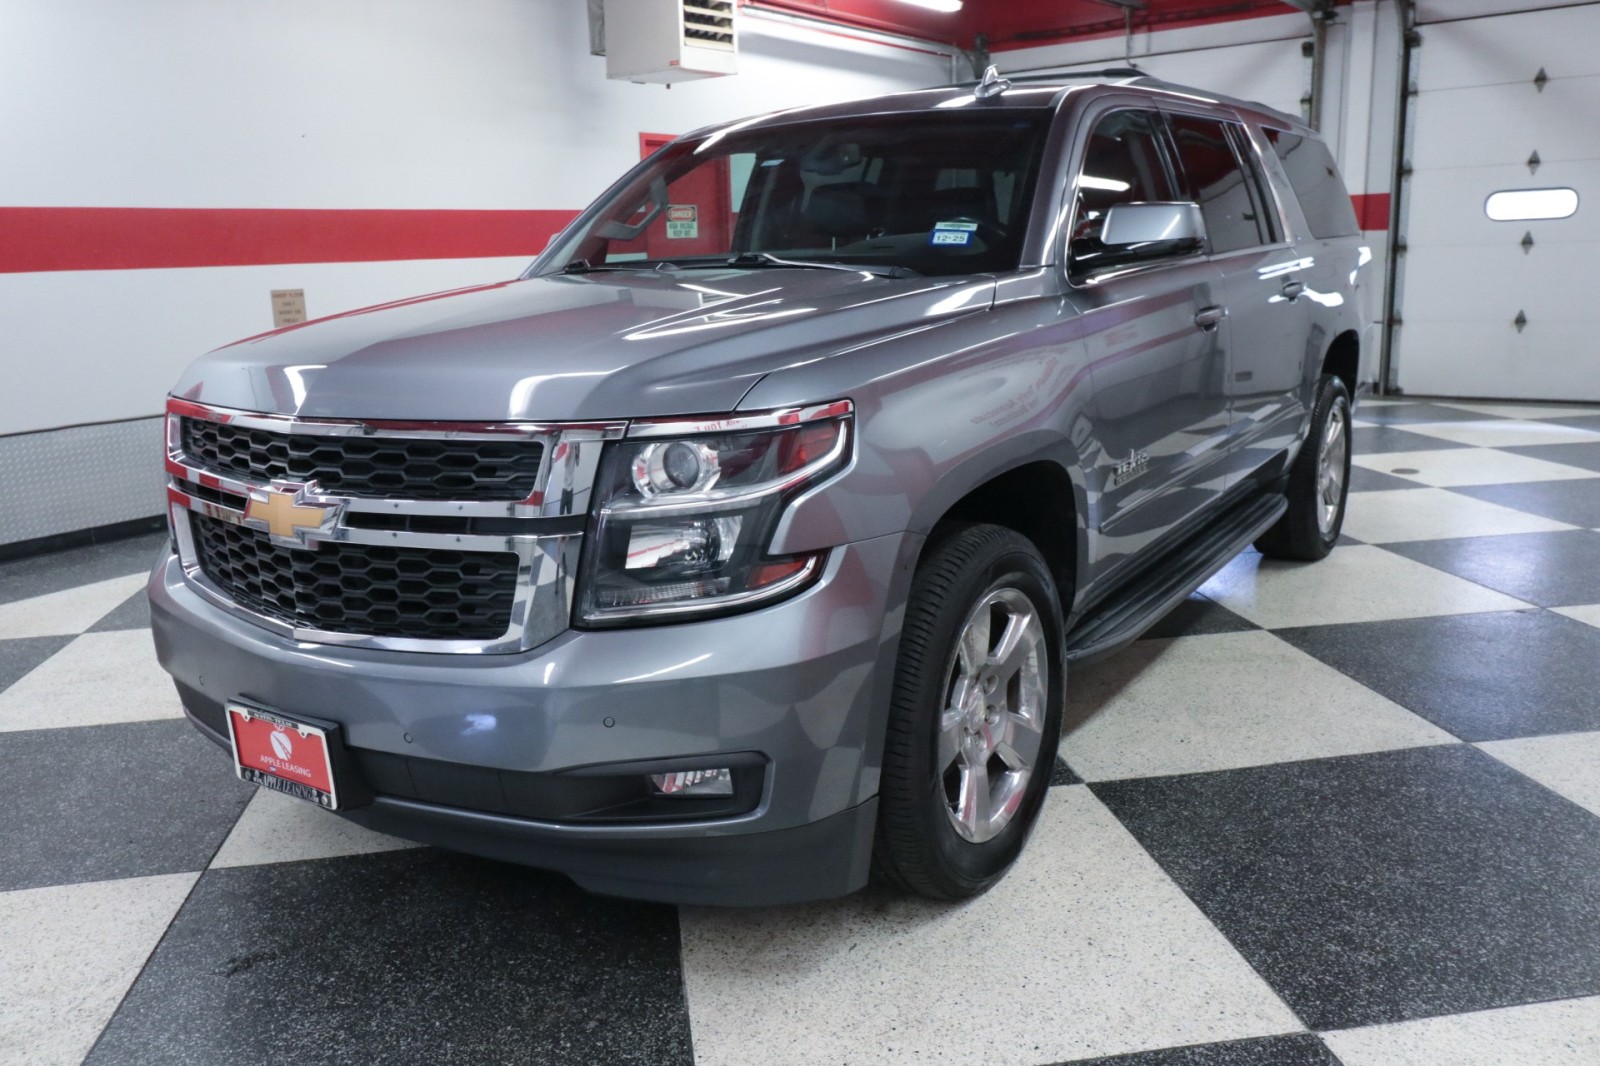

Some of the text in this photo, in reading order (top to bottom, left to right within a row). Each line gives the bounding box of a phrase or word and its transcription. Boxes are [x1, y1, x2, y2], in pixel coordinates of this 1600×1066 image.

[671, 210, 692, 218] DANGER
[260, 755, 312, 778] APPLE LEASING
[263, 774, 312, 799] APPLE LEASING
